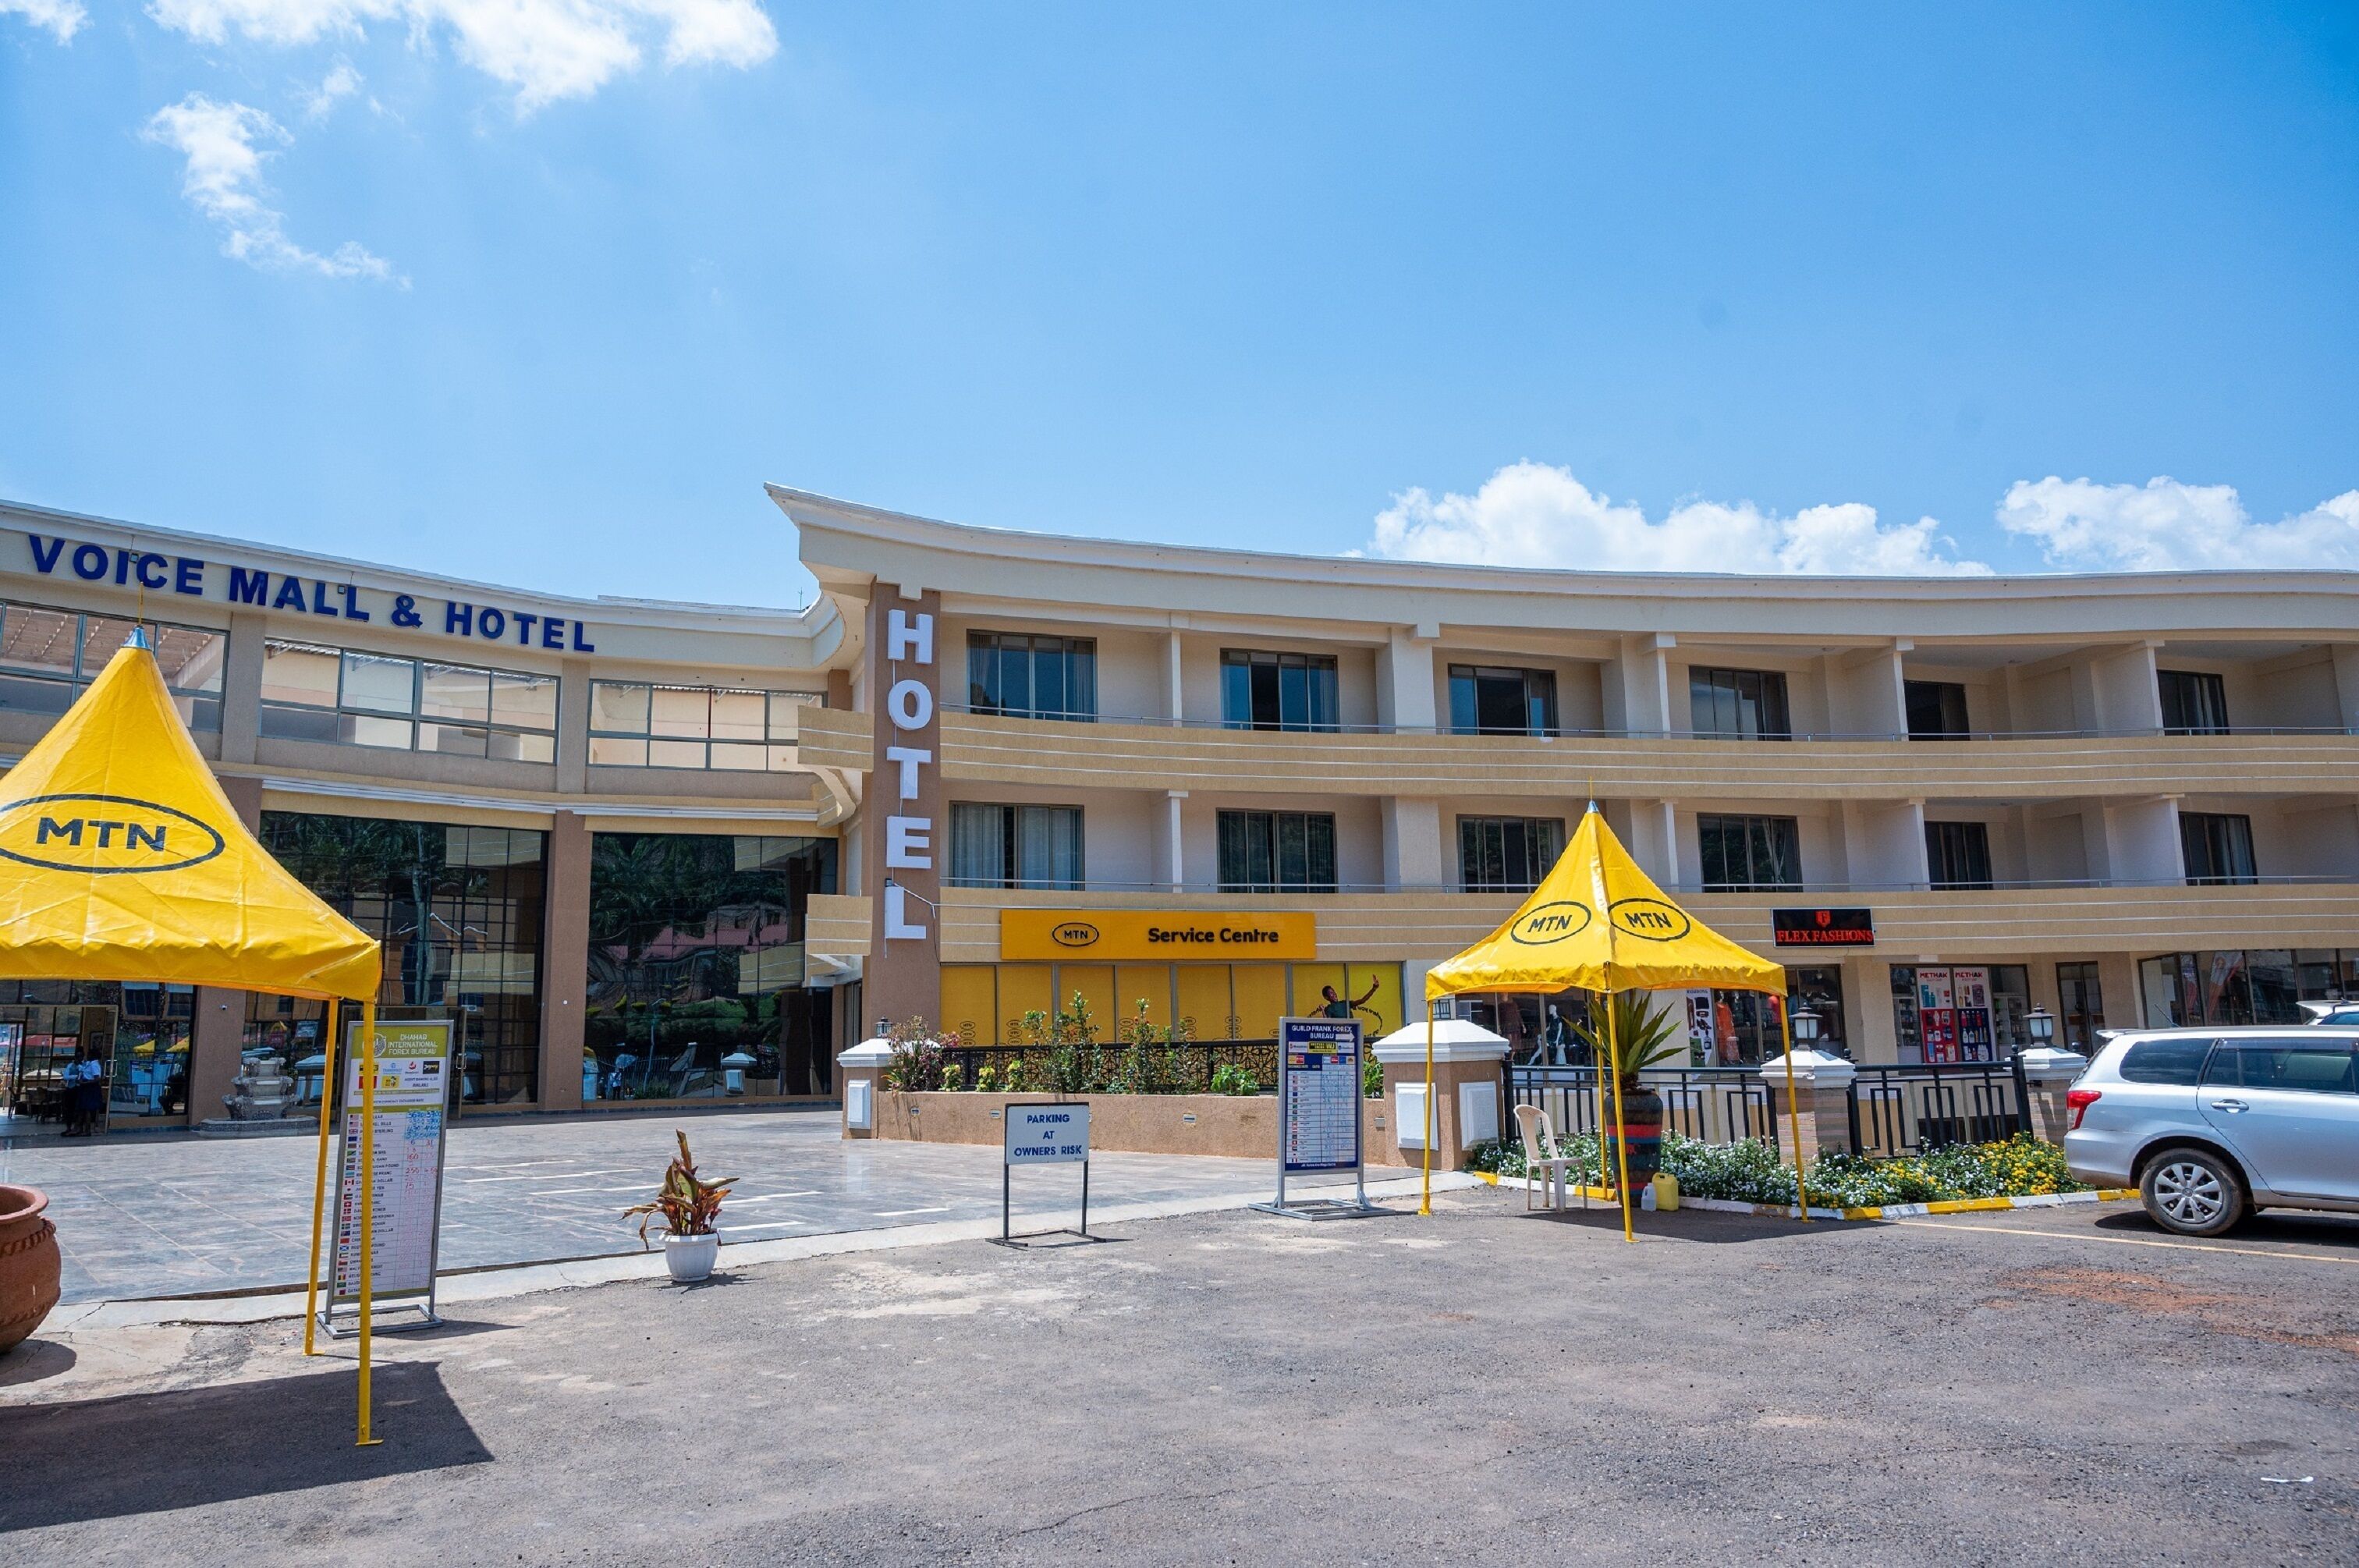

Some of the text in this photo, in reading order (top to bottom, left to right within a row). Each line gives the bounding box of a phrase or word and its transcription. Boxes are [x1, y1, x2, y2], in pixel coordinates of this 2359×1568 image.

[29, 534, 595, 653] VOICE MALL & HOTEL
[884, 608, 934, 941] HOTEL
[36, 817, 167, 852] MTN
[1527, 913, 1573, 934] MTN
[1624, 911, 1673, 929] MTN
[1062, 927, 1279, 944] MTN Service Centre
[1776, 929, 1874, 942] FLEX FASHIONS
[1027, 1113, 1070, 1123] PARKING
[1042, 1130, 1055, 1140] AT
[1013, 1144, 1083, 1156] OWNERS RISK
